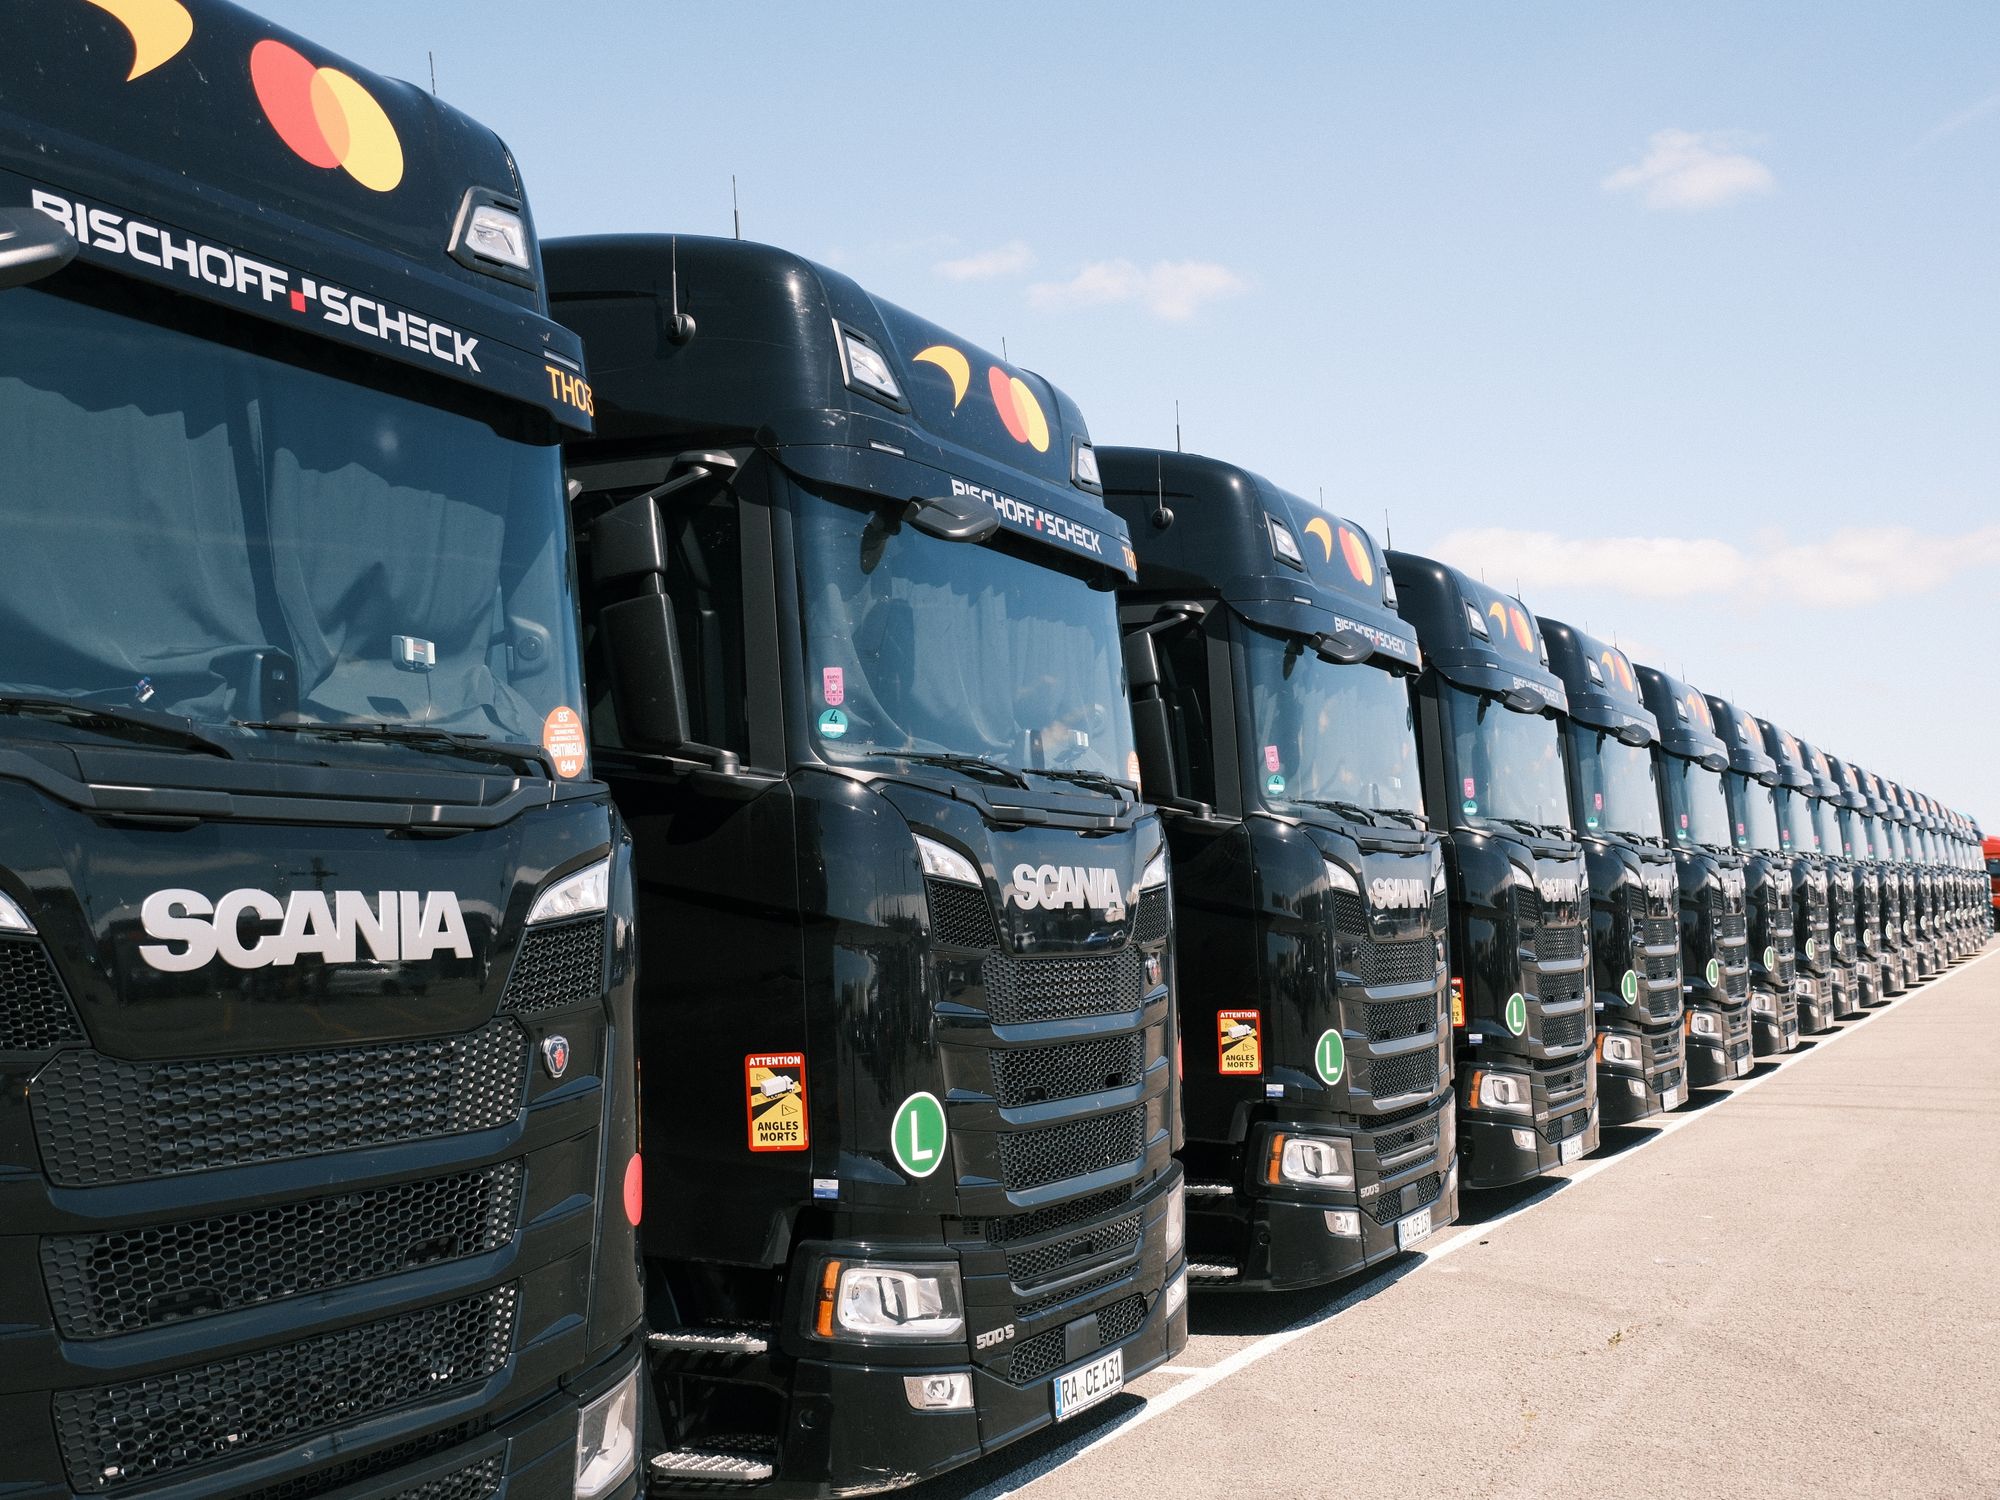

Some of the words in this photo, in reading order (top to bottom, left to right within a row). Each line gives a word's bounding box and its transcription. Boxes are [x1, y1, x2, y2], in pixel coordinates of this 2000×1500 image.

[32, 189, 288, 302] BISCHOFF
[320, 285, 482, 373] SCHECK
[1043, 514, 1103, 554] SCHECK
[829, 710, 839, 724] 4
[560, 760, 577, 772] 644
[1273, 775, 1280, 785] 4
[1012, 863, 1124, 911] SCANIA
[1372, 877, 1427, 910] SCANIA
[138, 888, 474, 973] SCANIA
[1627, 977, 1635, 998] L
[1220, 1011, 1257, 1019] ATTENTION
[1513, 1001, 1522, 1028] L
[749, 1055, 801, 1066] ATTENTION
[1325, 1040, 1338, 1075] L
[758, 1121, 799, 1132] ANGLES
[760, 1131, 798, 1142] MORTS
[910, 1110, 933, 1161] L
[1062, 1376, 1078, 1408] RA
[1085, 1366, 1100, 1397] CE
[1102, 1355, 1121, 1389] 131
